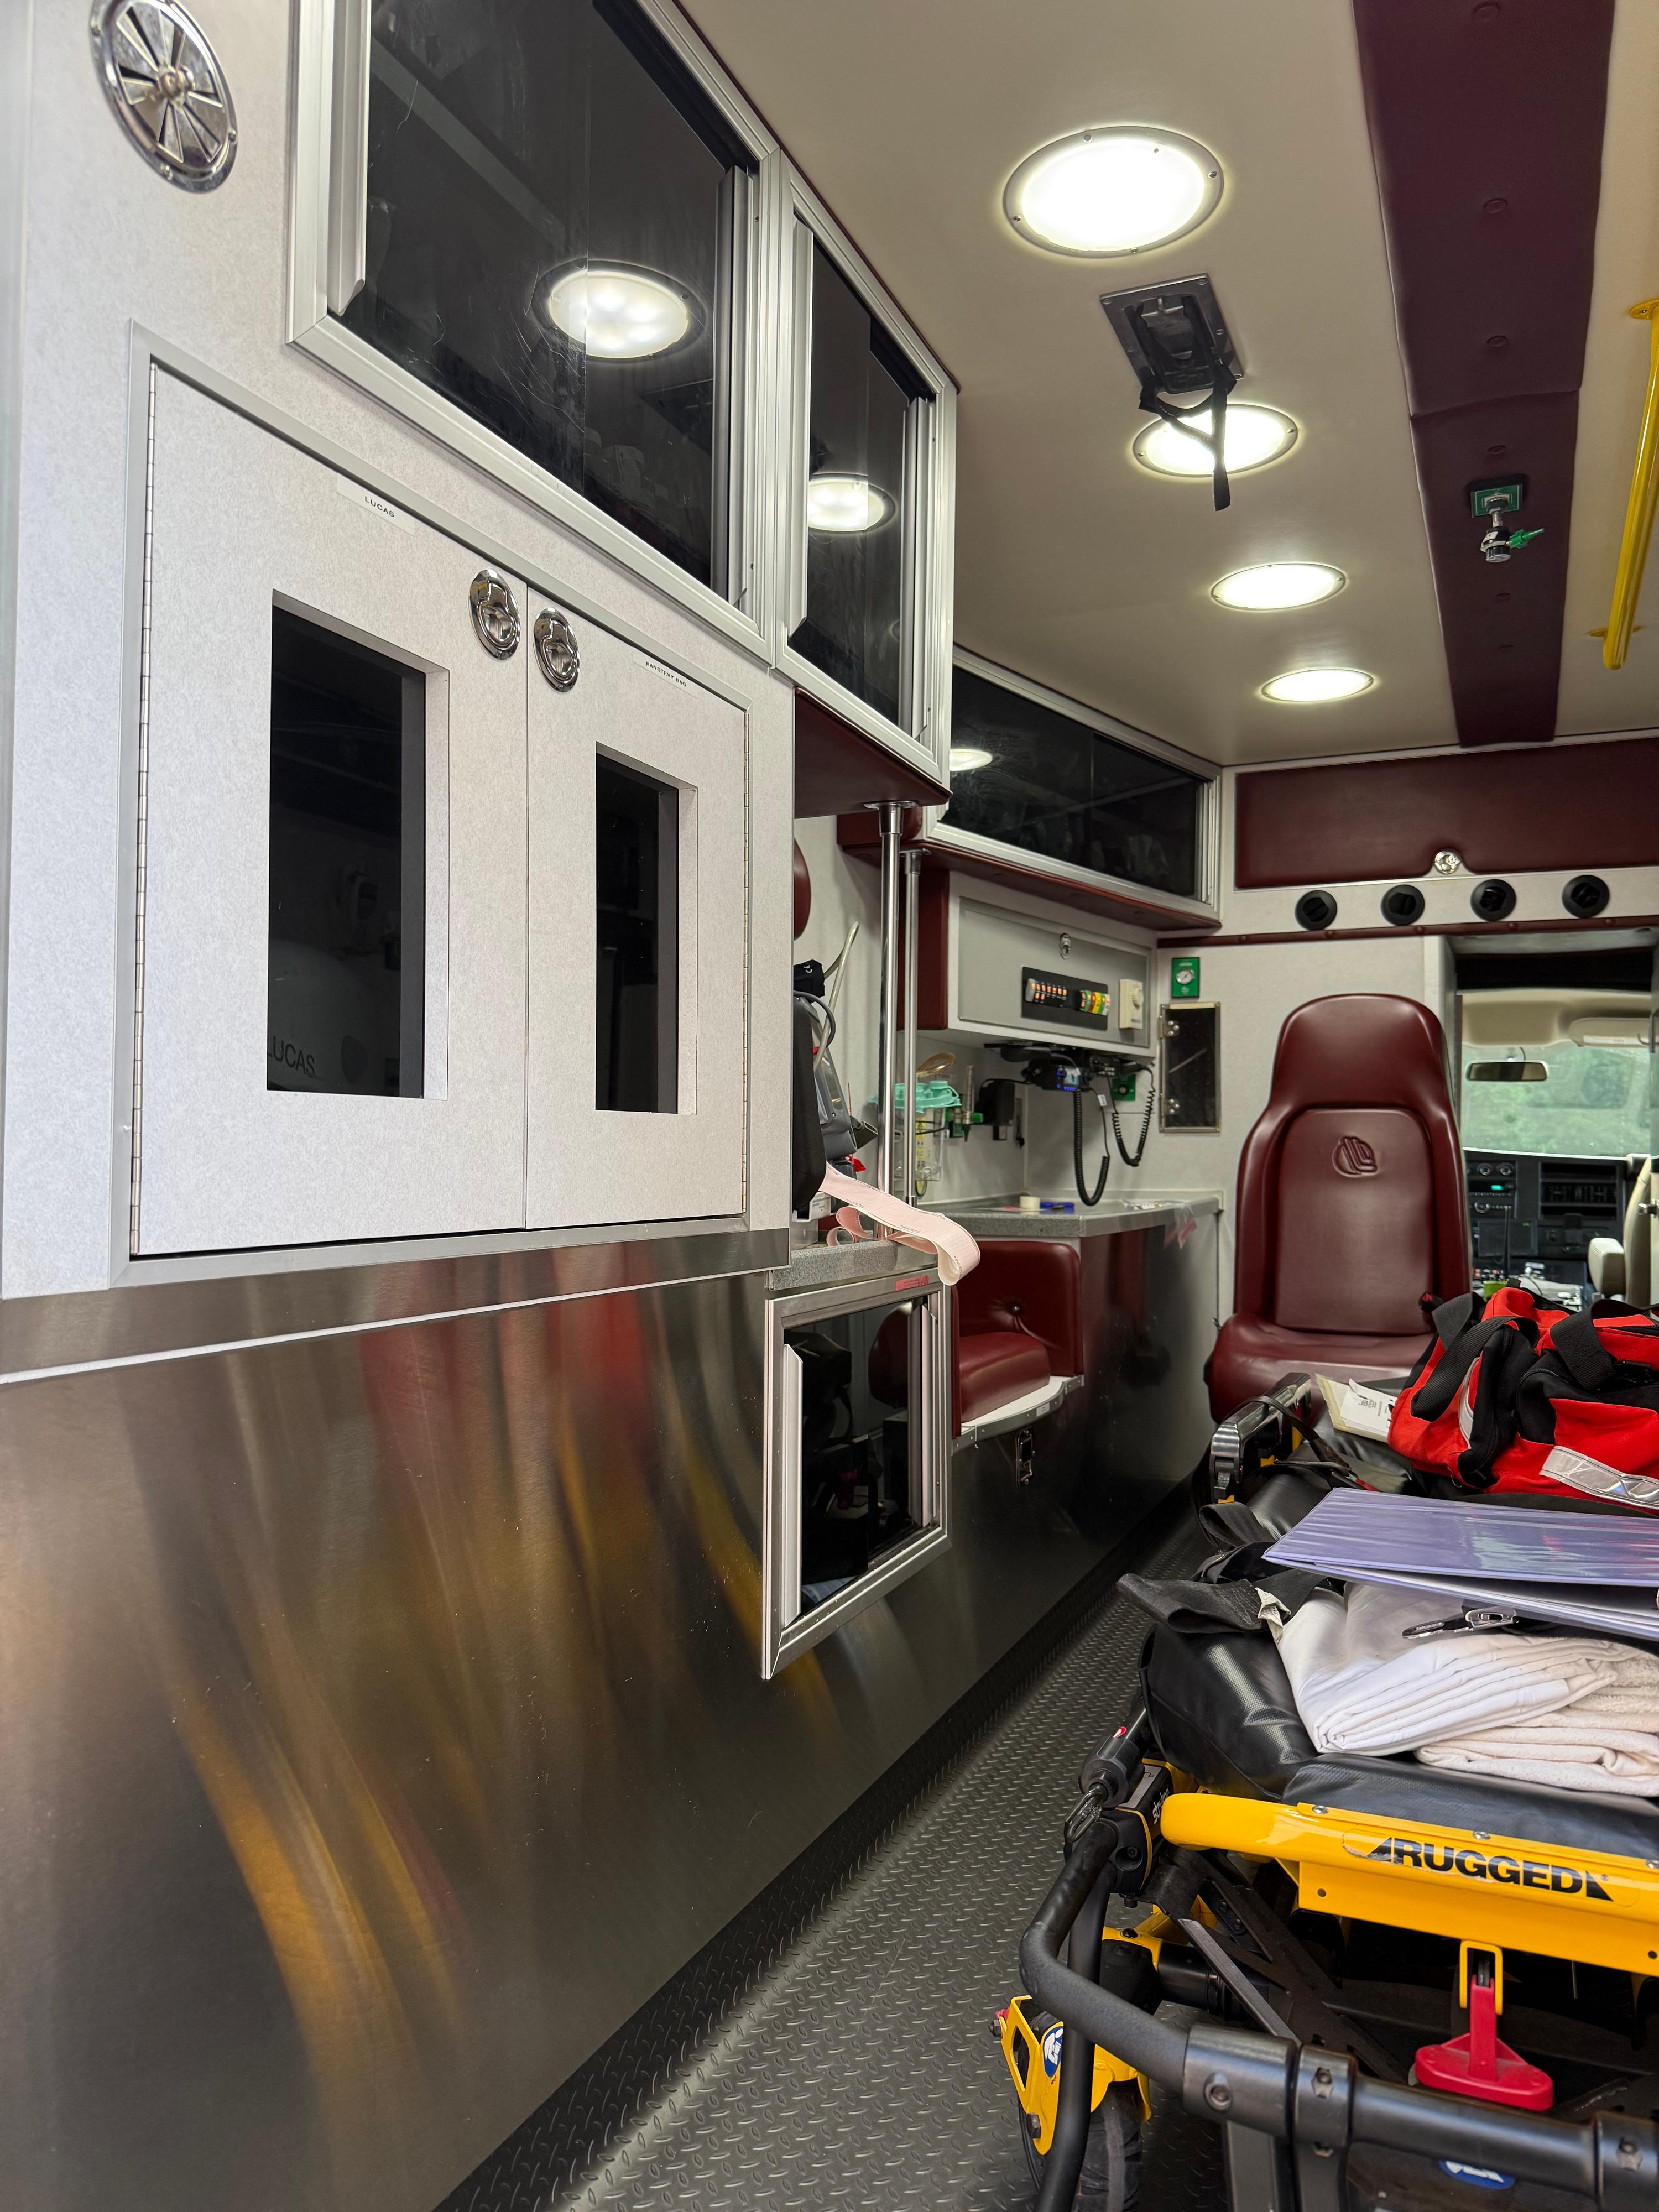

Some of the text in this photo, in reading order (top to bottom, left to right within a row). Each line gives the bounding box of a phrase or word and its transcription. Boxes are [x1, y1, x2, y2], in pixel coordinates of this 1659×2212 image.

[364, 495, 394, 518] LUCAS
[645, 661, 687, 687] HANDTEVY BAG
[267, 1035, 315, 1078] UCAS
[1394, 1837, 1583, 1894] RUGGED
